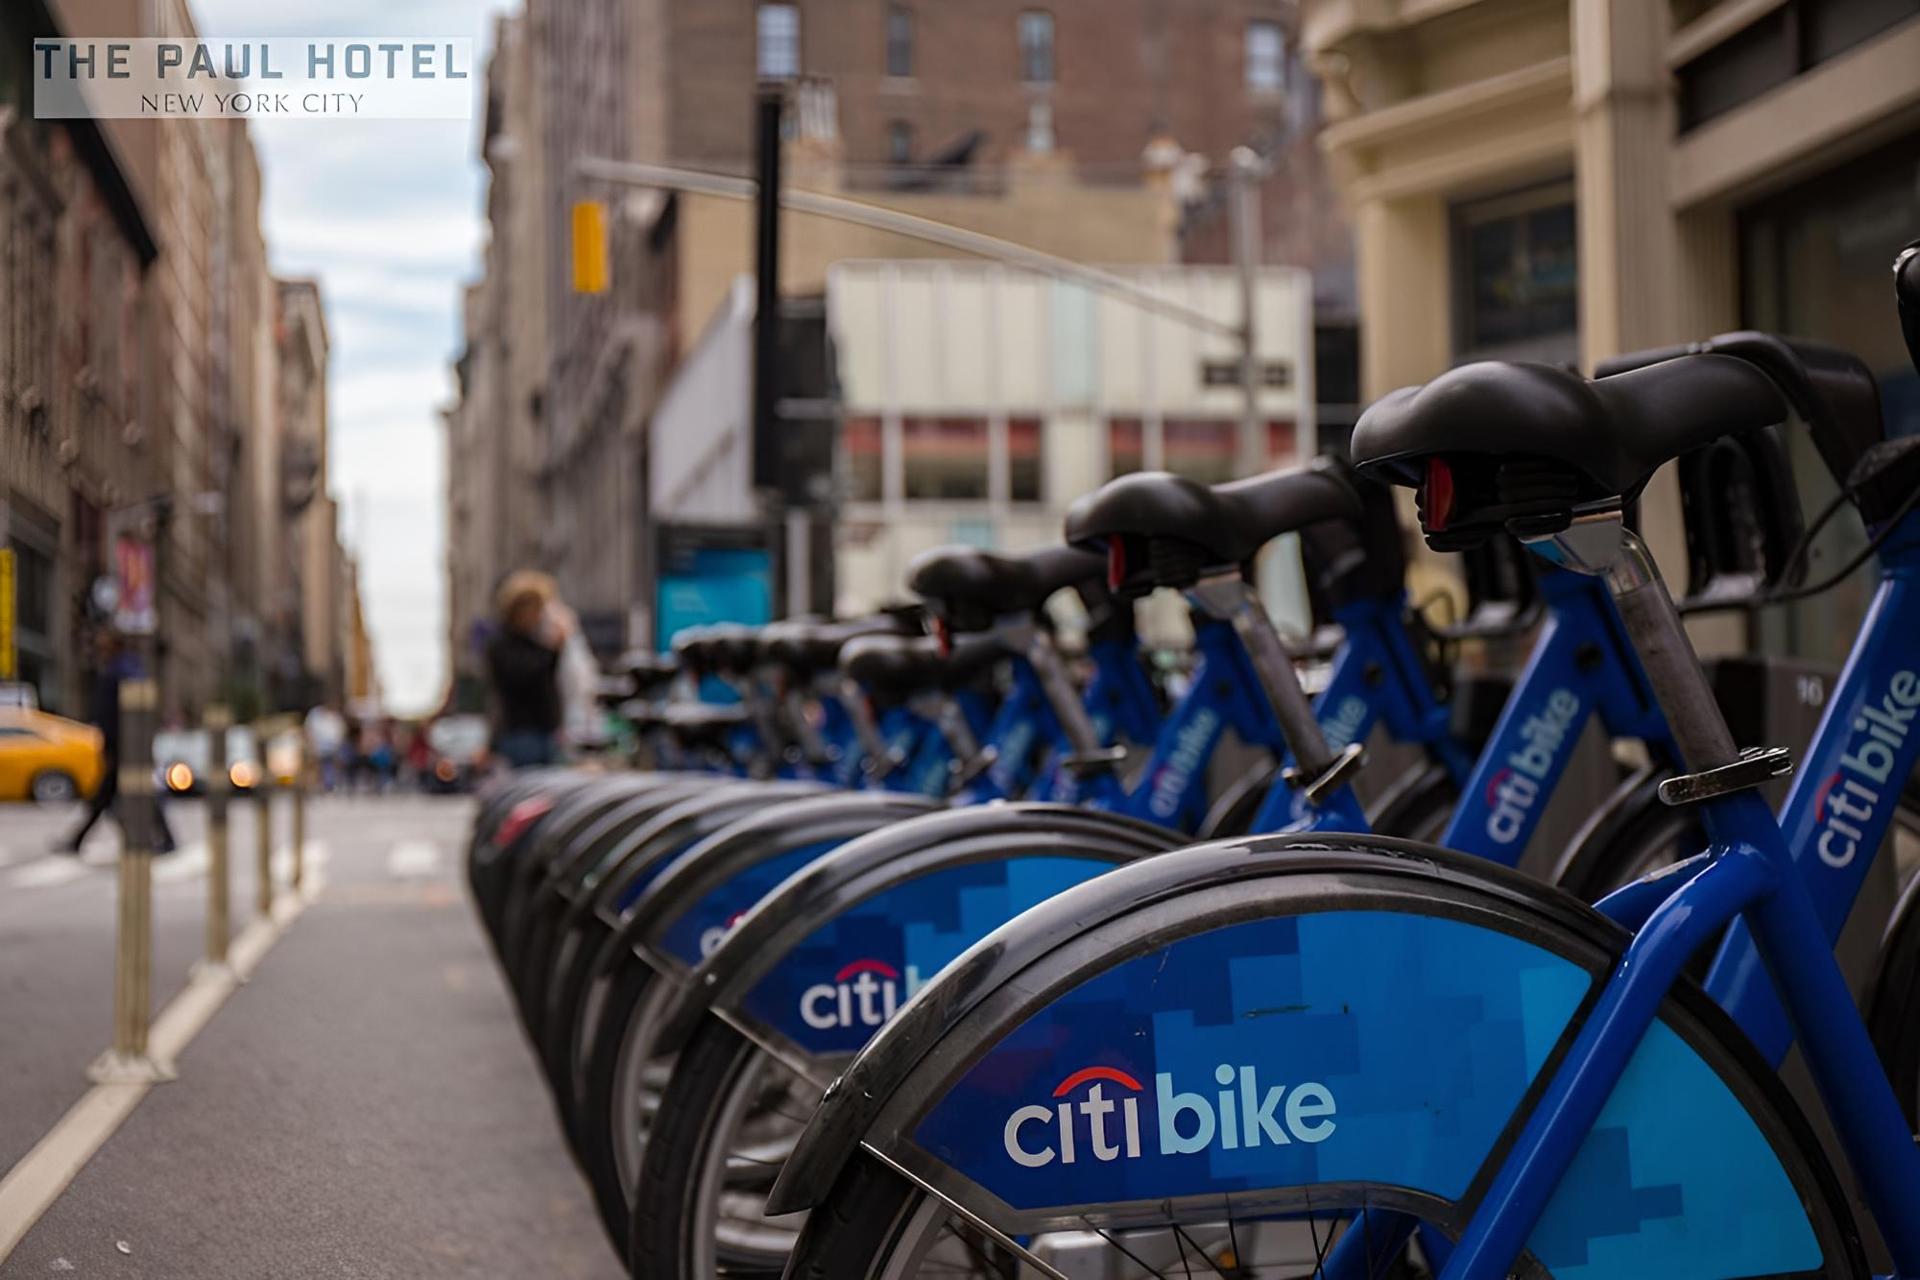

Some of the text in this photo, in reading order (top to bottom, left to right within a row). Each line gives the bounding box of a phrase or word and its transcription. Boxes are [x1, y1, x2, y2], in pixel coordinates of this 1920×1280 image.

[1815, 670, 1920, 868] citi bike
[800, 959, 898, 1029] citi
[1004, 1063, 1336, 1168] citi bike
